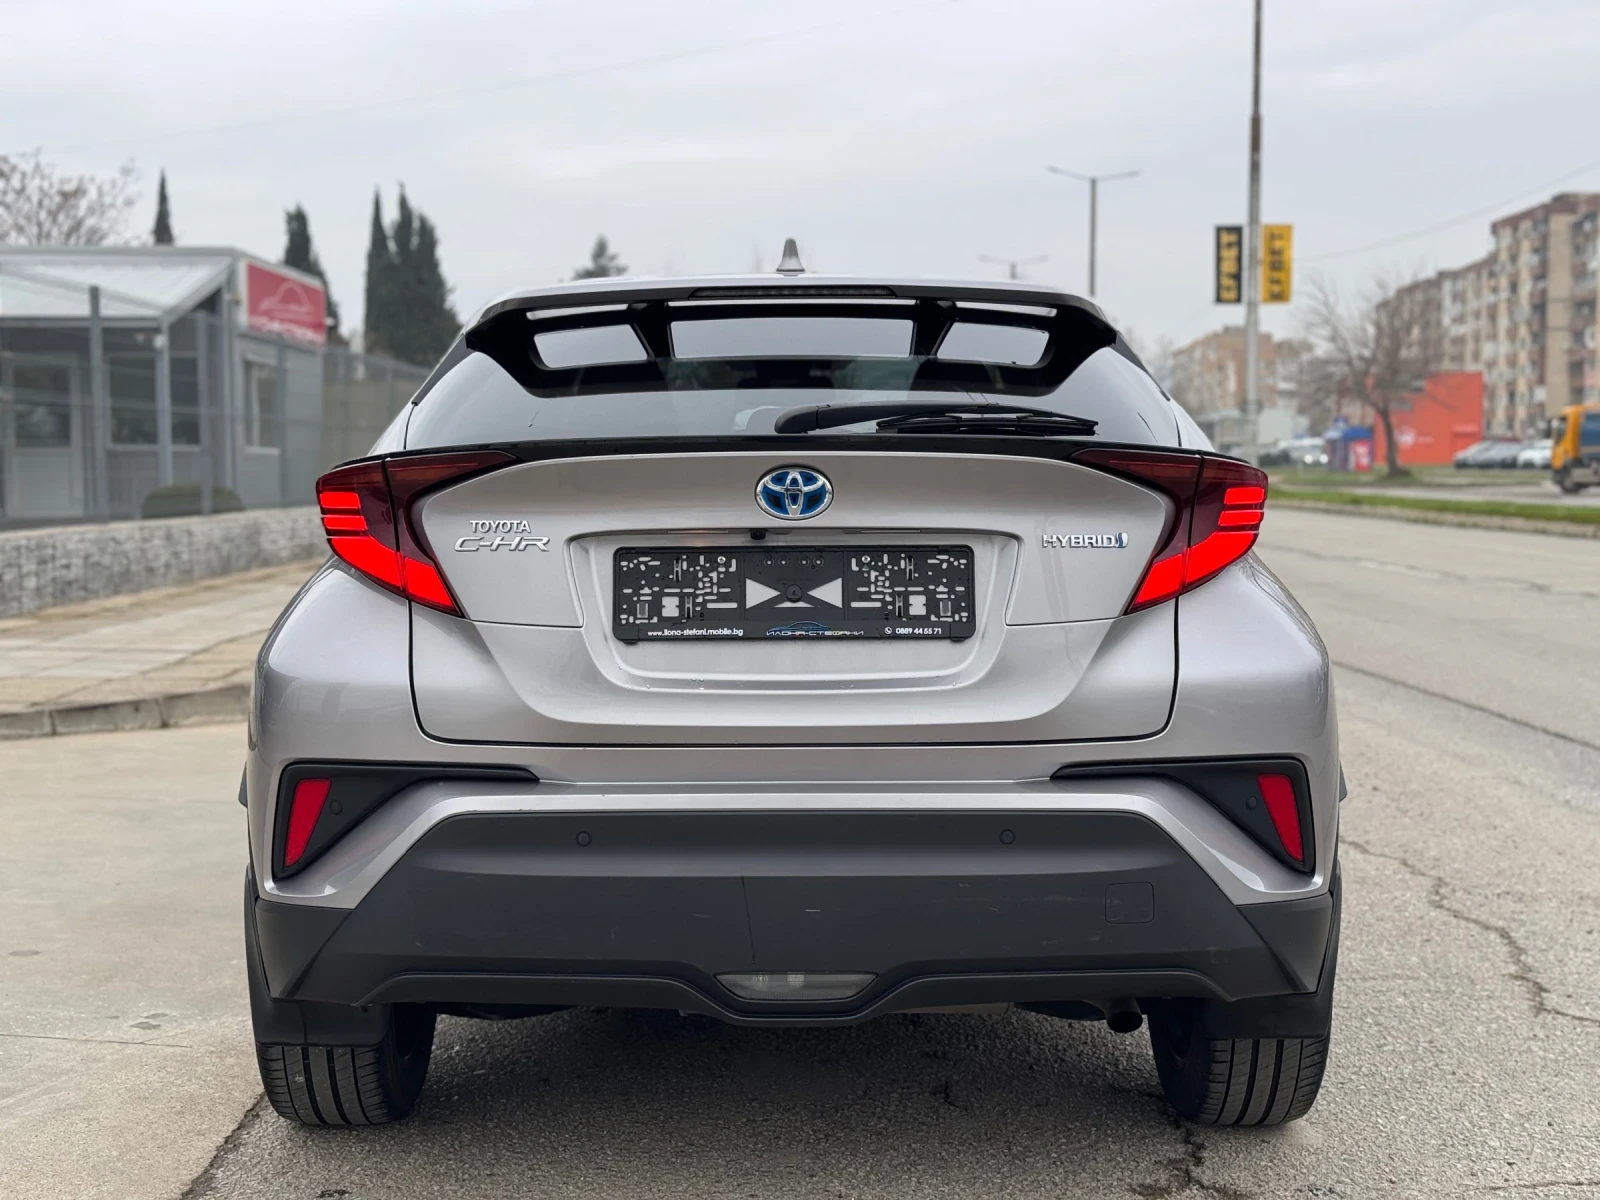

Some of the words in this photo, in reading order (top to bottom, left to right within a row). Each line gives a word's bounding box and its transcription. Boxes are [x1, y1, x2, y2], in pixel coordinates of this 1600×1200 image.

[469, 520, 531, 533] TOYOTA
[454, 536, 550, 552] C-HR
[1042, 534, 1115, 548] HYBRID
[647, 623, 744, 637] www.ilona-stefani.mobile.bg
[895, 627, 913, 635] 0889
[913, 627, 923, 635] 44
[933, 627, 942, 635] 71
